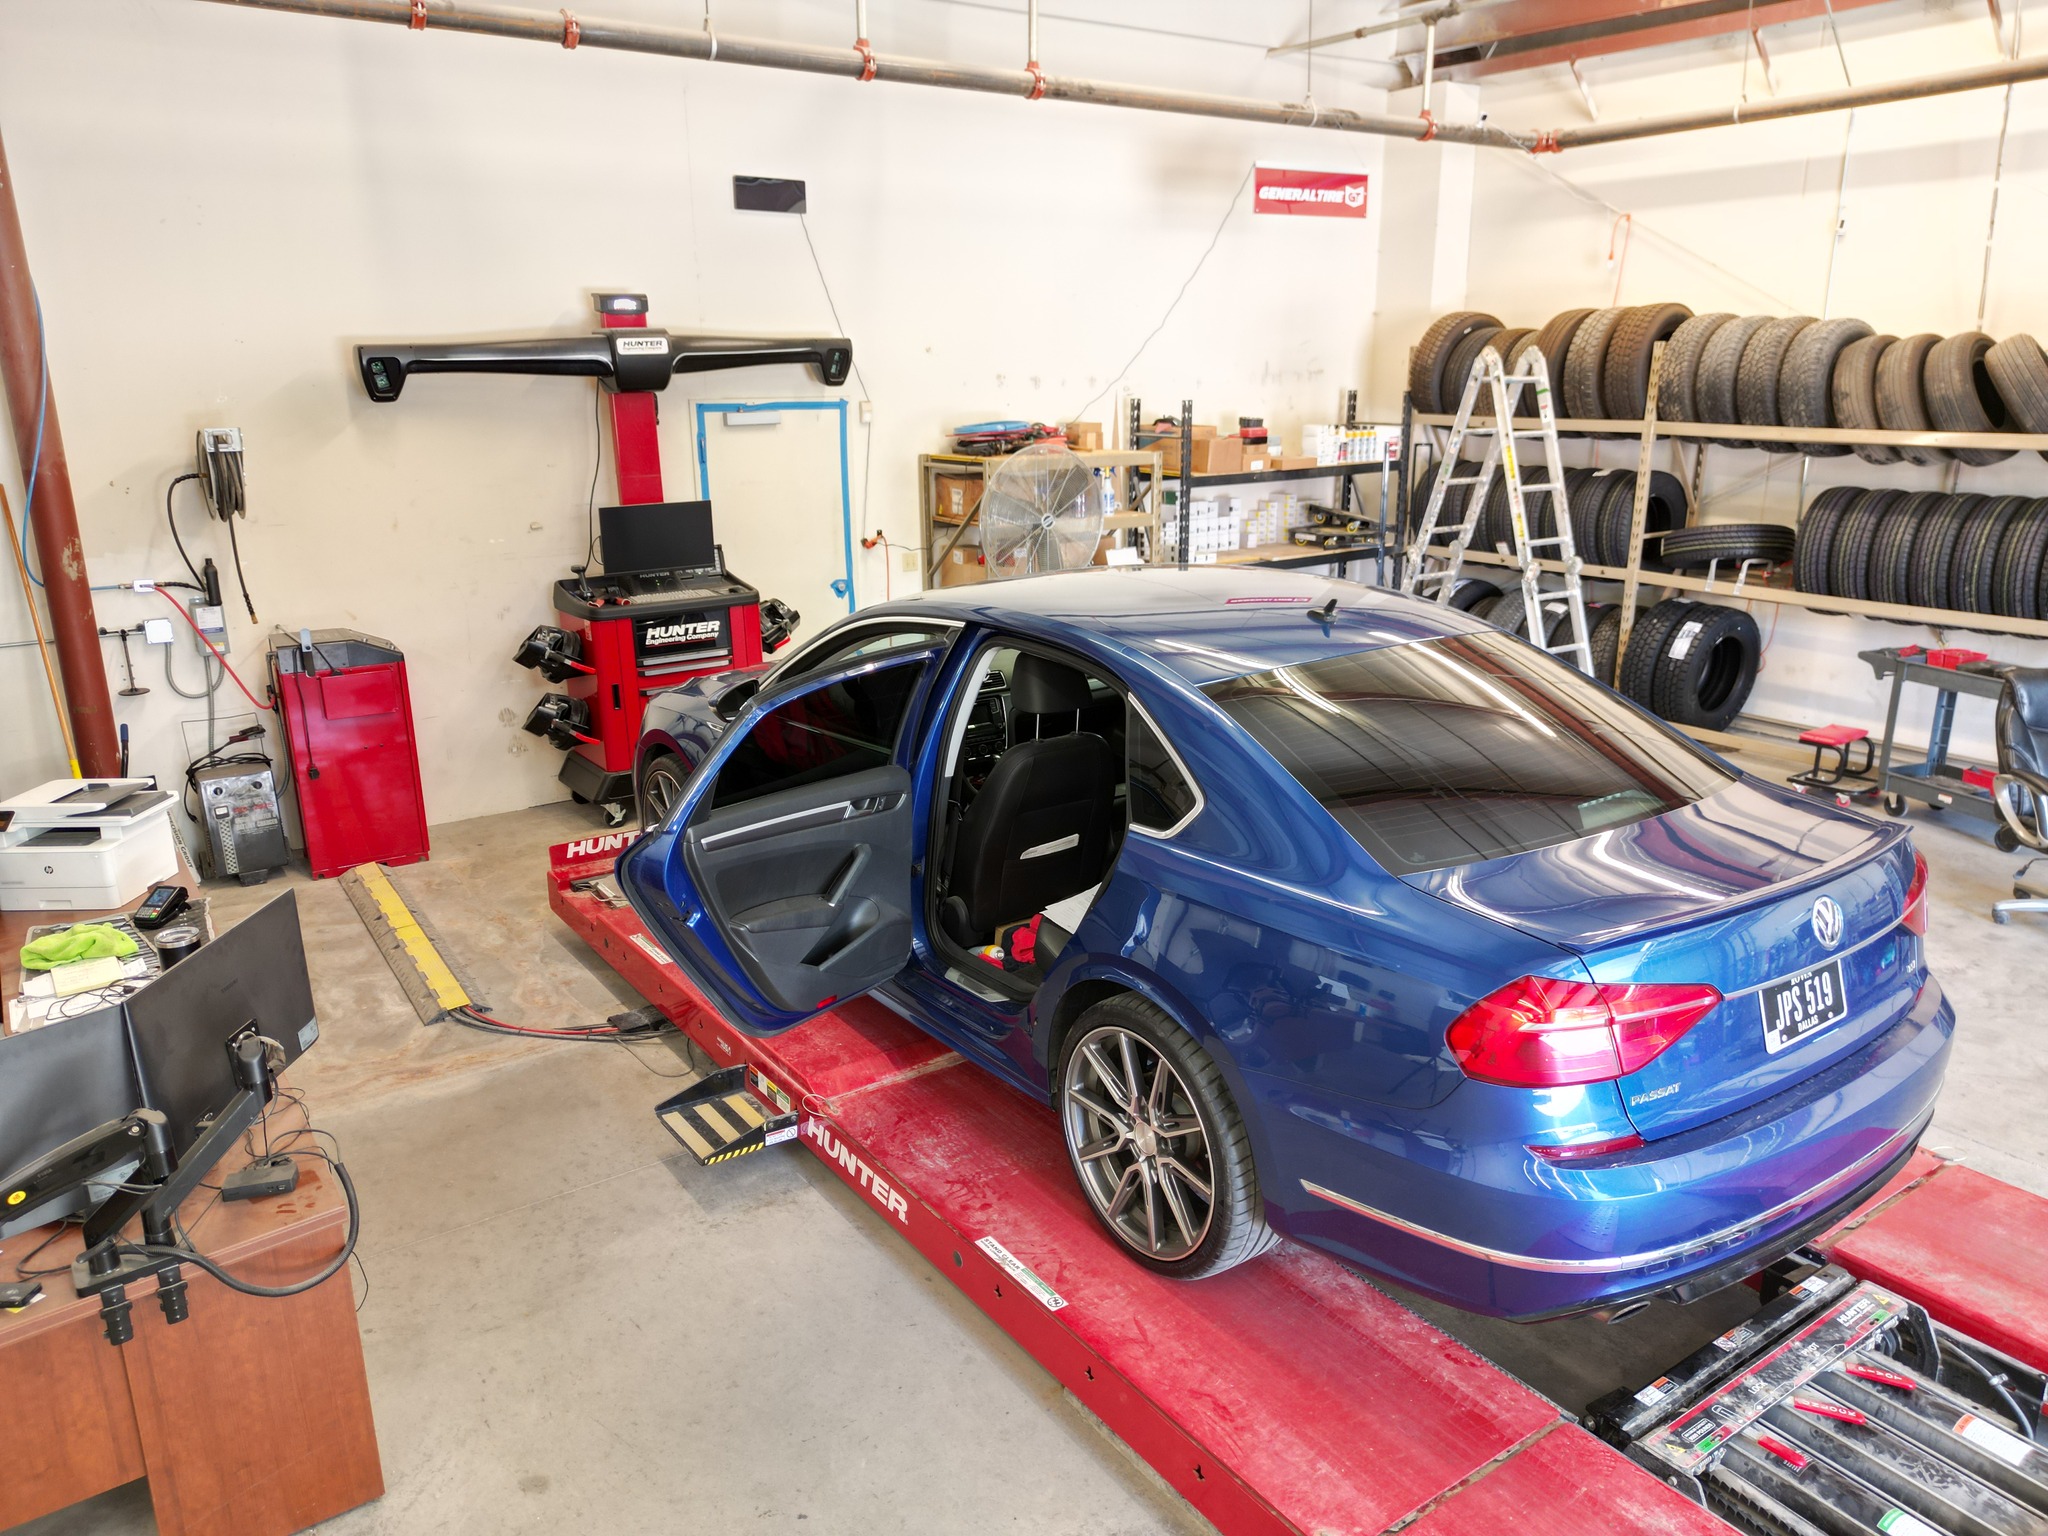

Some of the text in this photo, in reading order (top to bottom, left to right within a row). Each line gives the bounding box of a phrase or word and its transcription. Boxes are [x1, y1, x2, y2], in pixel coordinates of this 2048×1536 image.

[645, 632, 719, 645] Engineering Company
[646, 621, 720, 639] HUNTER
[566, 831, 641, 858] HUNT
[1775, 971, 1833, 1031] JPS 519
[1797, 1015, 1819, 1033] DALLAS
[1630, 1082, 1681, 1107] PASSAT
[808, 1116, 908, 1225] HUNTER
[984, 1238, 1020, 1269] STAND CLEAR
[1836, 1298, 1871, 1325] HUNTER
[1858, 1366, 1903, 1381] PIVOT
[1747, 1380, 1768, 1394] LOCK
